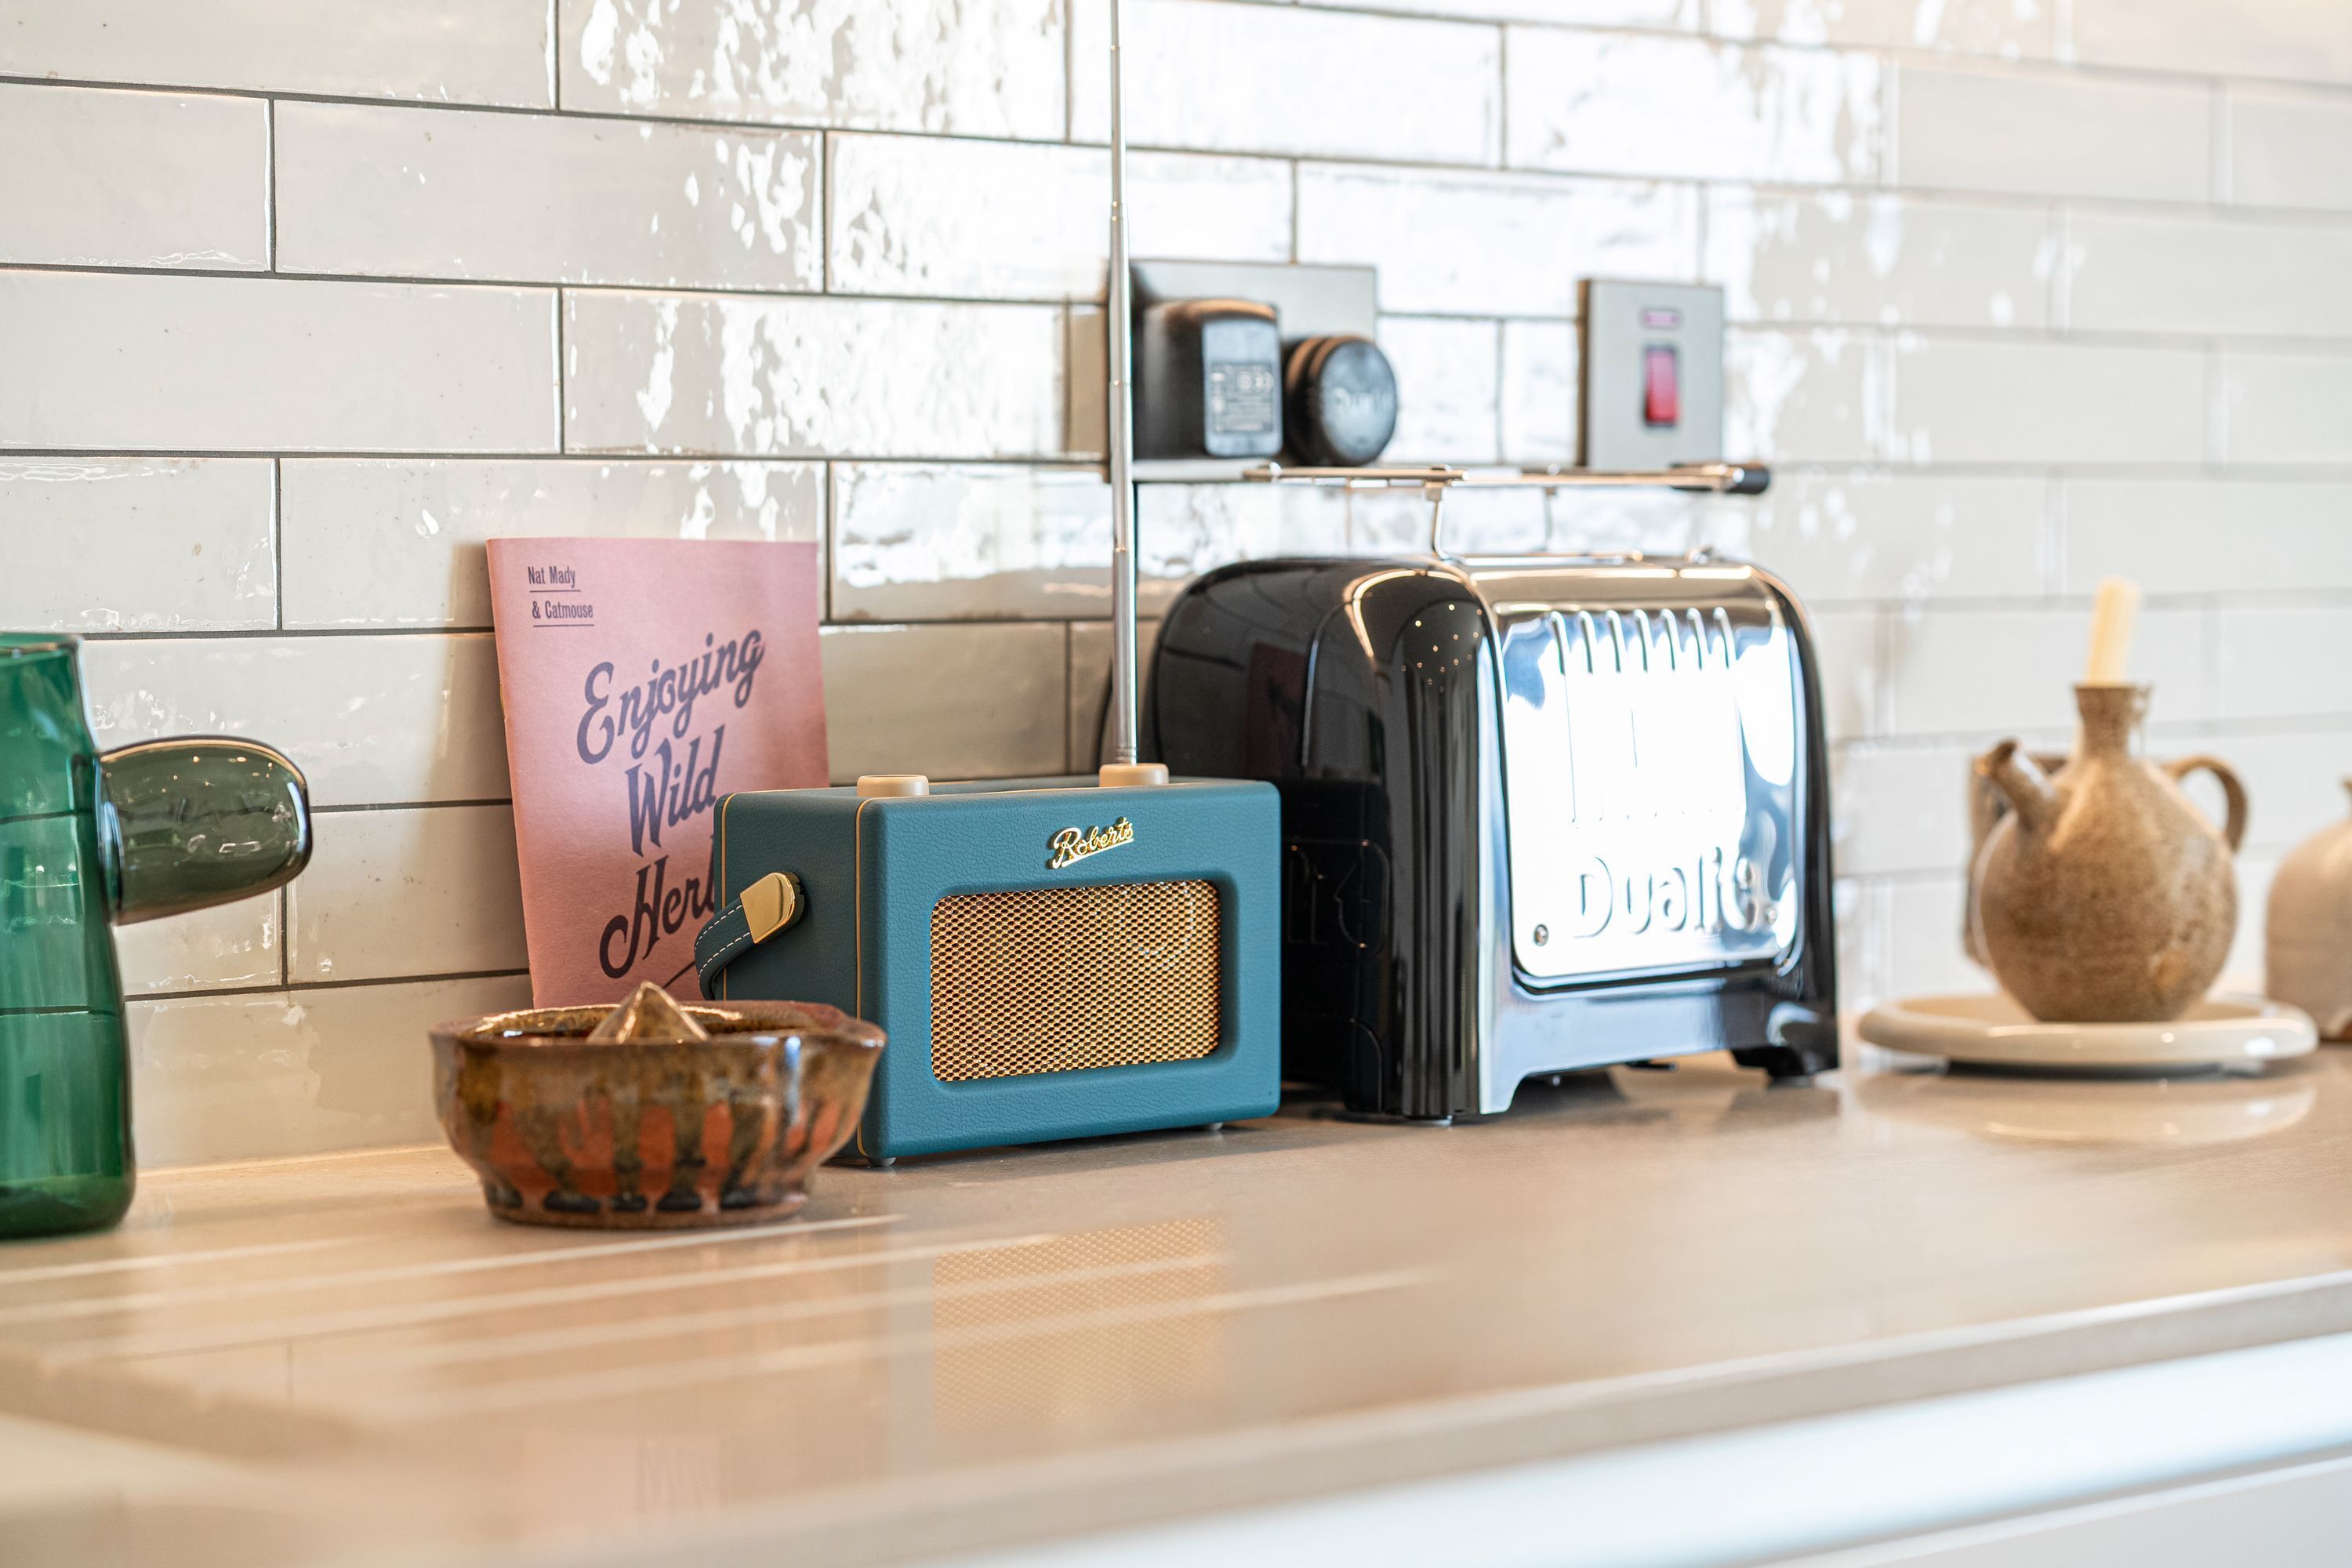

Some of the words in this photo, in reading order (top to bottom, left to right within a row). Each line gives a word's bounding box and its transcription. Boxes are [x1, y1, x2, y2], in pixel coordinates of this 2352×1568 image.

[528, 566, 546, 584] Nat
[549, 566, 575, 589] Mady
[532, 601, 541, 619] &
[545, 601, 593, 619] Catmouse
[577, 630, 765, 764] Enjoying
[625, 724, 725, 857] Wild
[1051, 817, 1134, 869] Roberts
